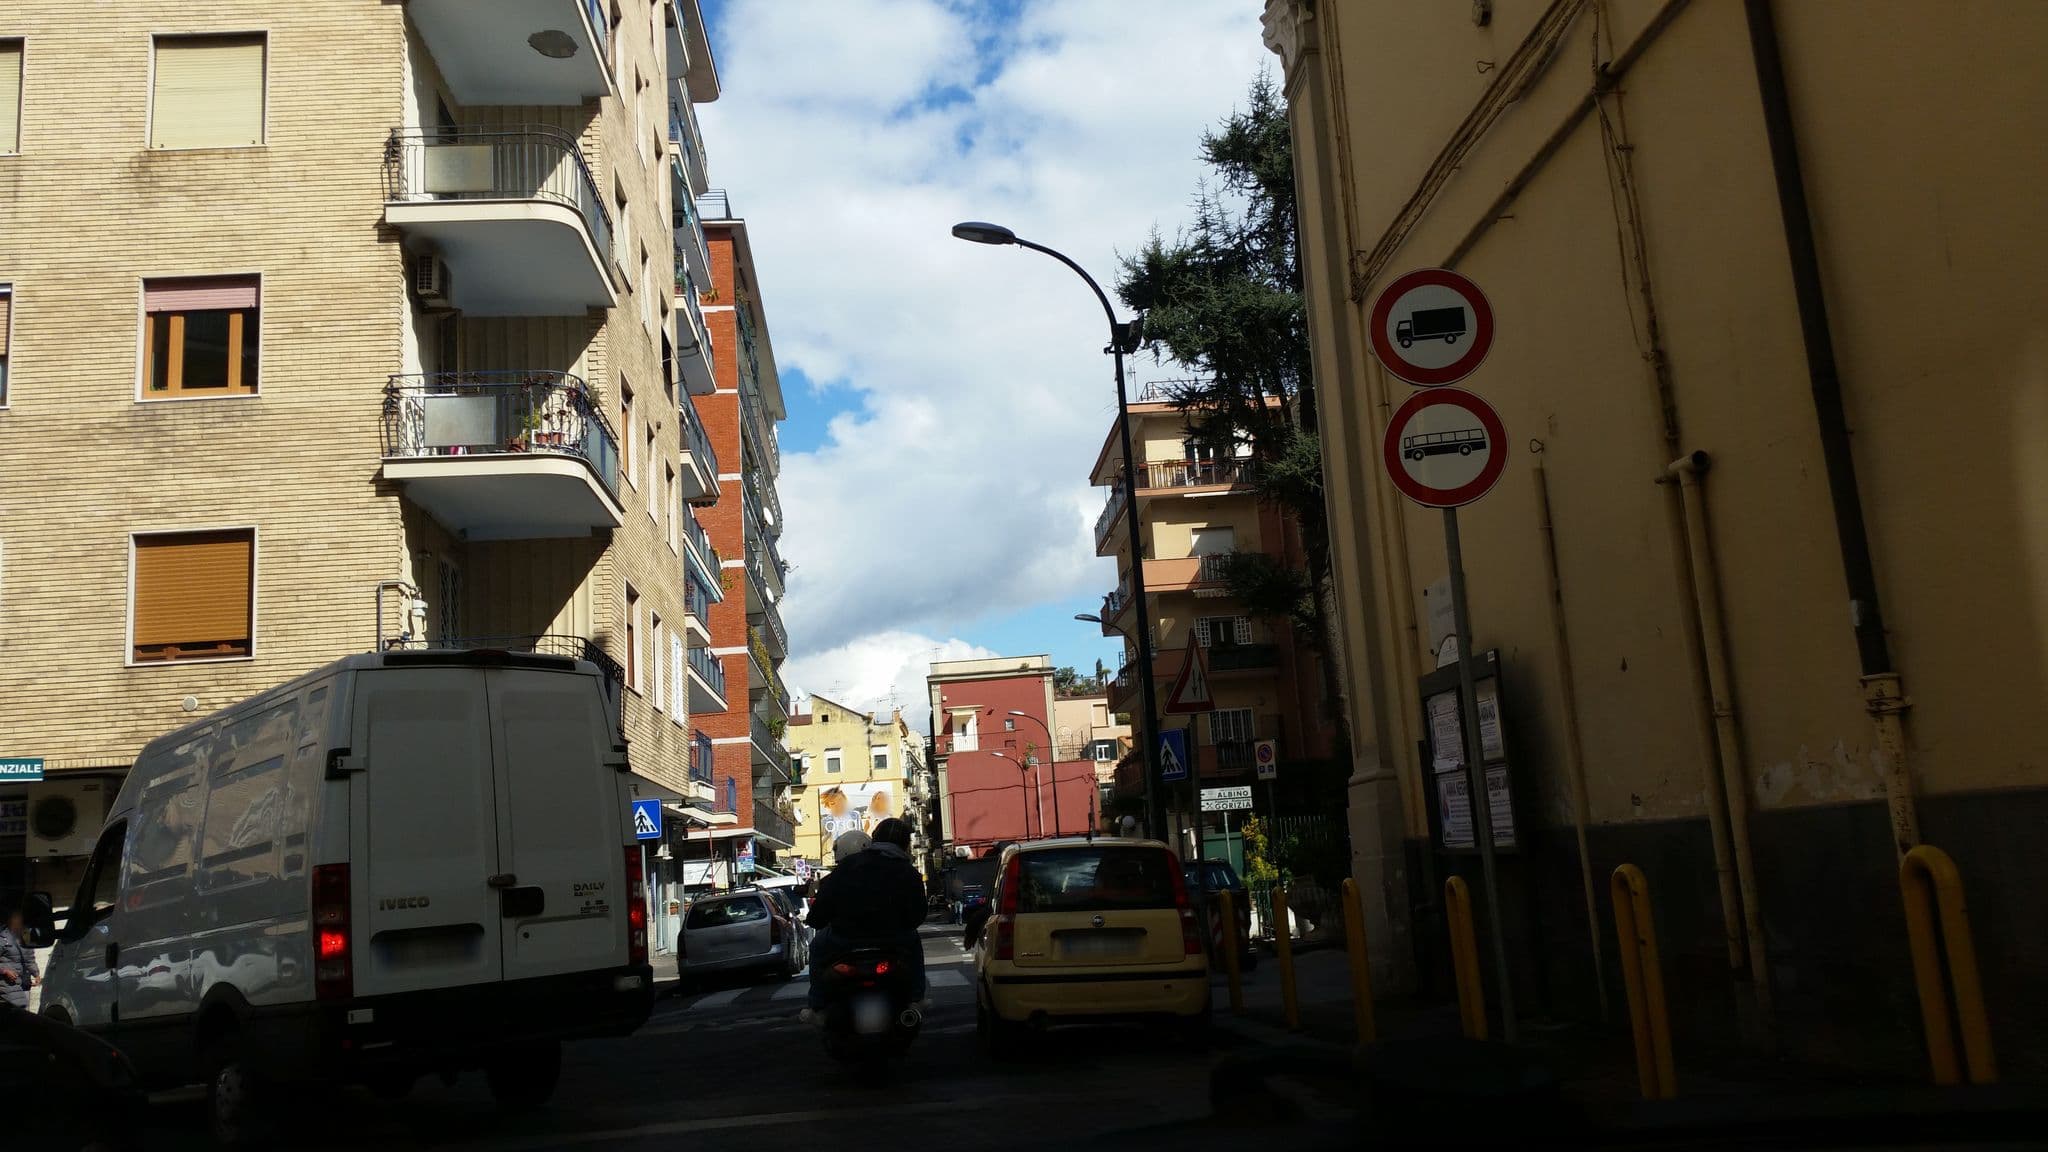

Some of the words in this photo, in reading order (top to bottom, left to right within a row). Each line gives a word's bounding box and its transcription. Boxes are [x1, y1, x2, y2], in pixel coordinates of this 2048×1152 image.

[1217, 790, 1249, 798] ALBINO
[1214, 801, 1252, 810] GORIZIA
[573, 882, 605, 891] DAILY
[379, 896, 430, 911] IVECO
